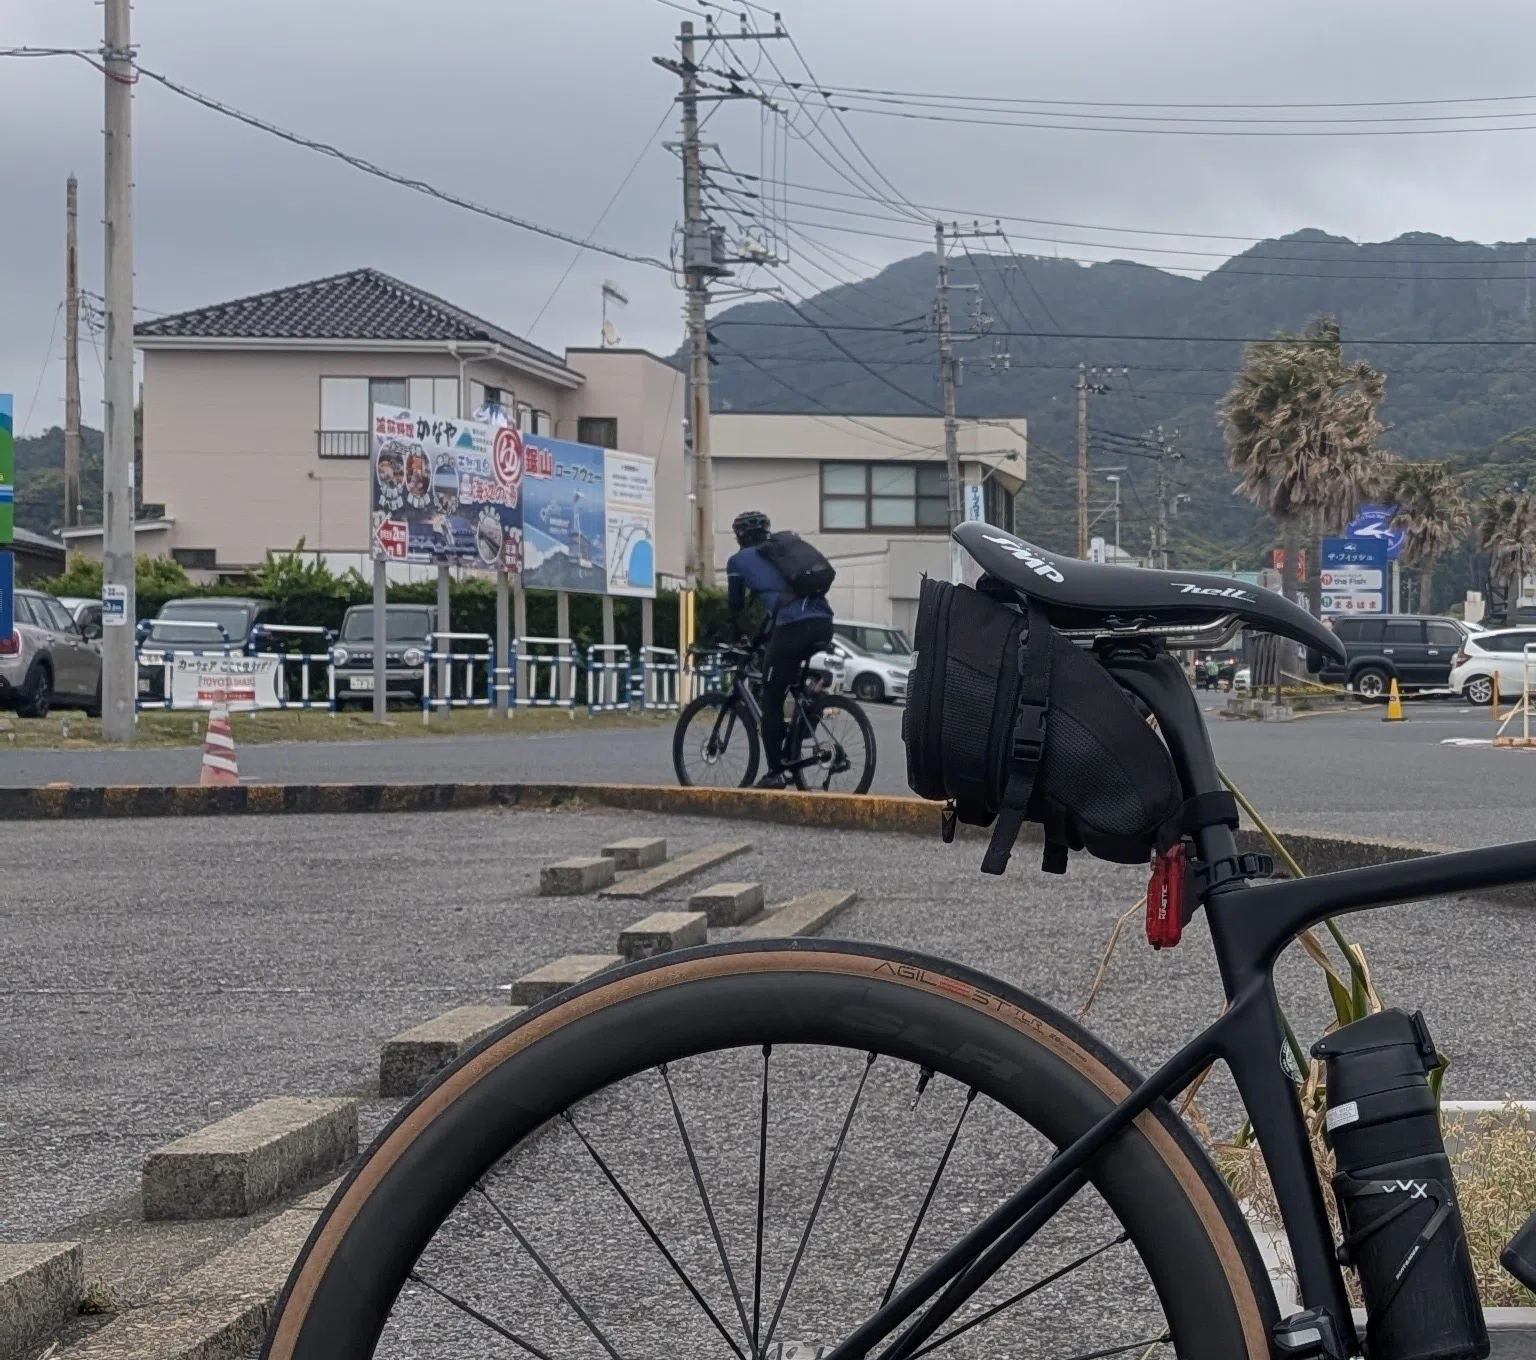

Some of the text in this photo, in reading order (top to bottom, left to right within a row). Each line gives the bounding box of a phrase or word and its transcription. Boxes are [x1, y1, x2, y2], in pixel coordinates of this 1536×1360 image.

[416, 417, 457, 447] かなや
[555, 464, 602, 484] ロープウェー
